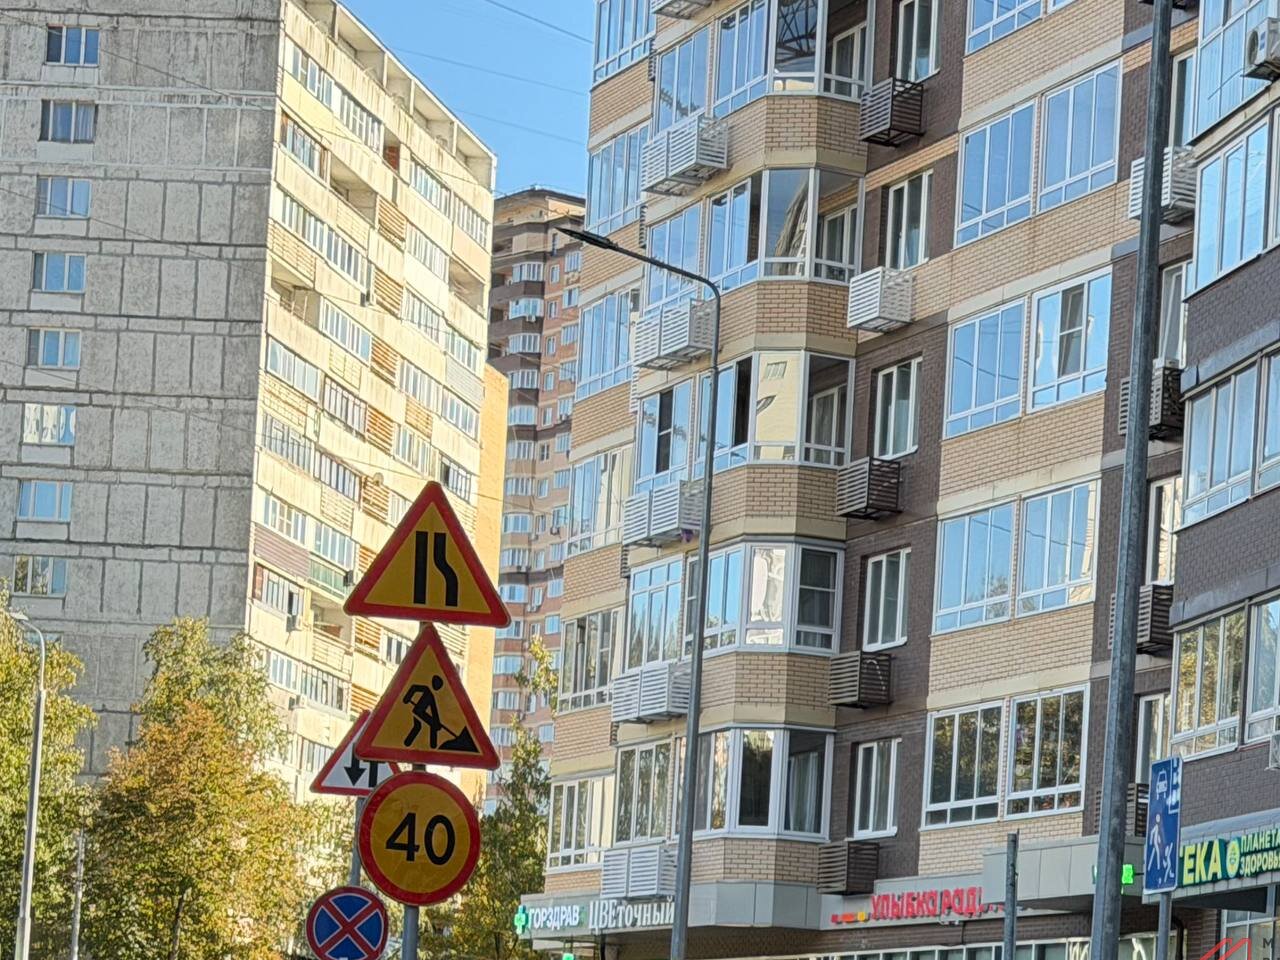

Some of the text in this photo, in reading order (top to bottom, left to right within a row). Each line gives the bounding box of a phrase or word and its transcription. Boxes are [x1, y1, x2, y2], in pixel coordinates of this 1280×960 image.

[385, 812, 456, 866] 40
[1180, 839, 1222, 885] ЕКА
[528, 905, 580, 931] ГОРЗДРАВ
